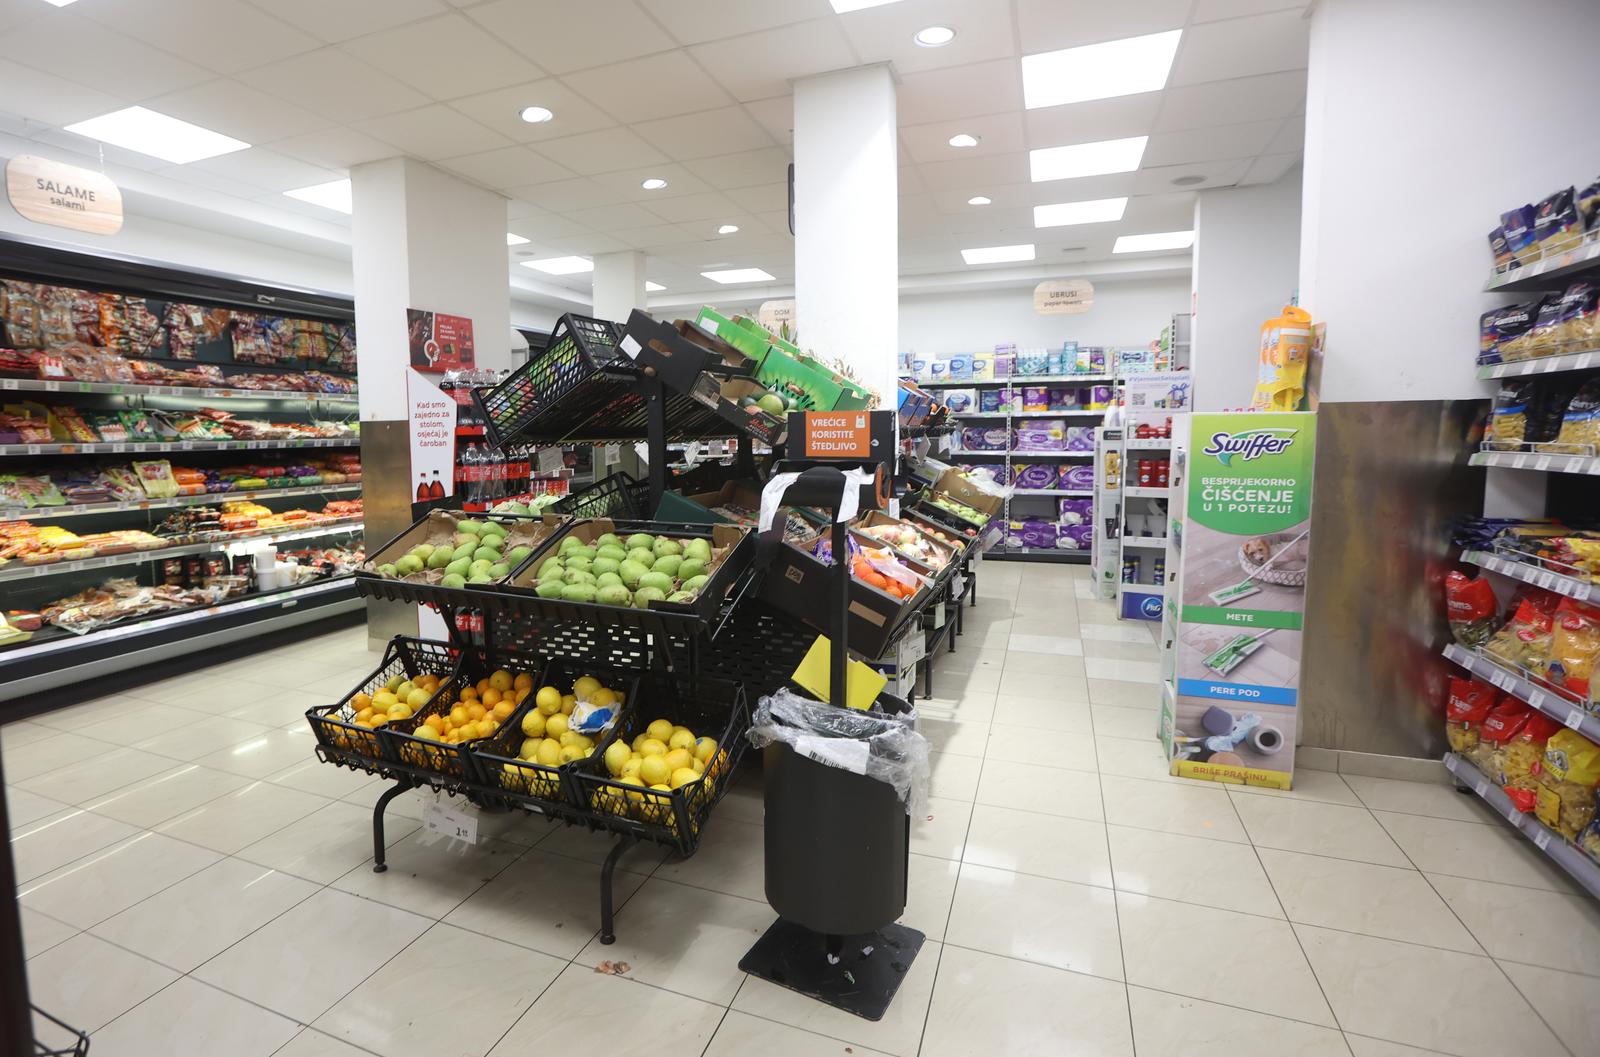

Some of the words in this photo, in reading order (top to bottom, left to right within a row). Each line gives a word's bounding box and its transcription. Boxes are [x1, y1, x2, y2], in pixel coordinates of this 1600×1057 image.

[37, 179, 96, 202] SALAME
[50, 197, 86, 211] salami
[416, 401, 430, 410] Kad
[431, 401, 446, 409] smo
[414, 411, 440, 419] zajedno
[811, 418, 847, 428] VREĆICE
[811, 430, 854, 440] KORISTITE
[811, 441, 857, 452] ŠTEDLJIVO
[1203, 432, 1292, 460] Swiffer
[1201, 477, 1297, 487] BESPRIJEKORNO
[1202, 486, 1294, 503] ČIŠĆENJE
[1203, 503, 1212, 512] U
[1218, 503, 1223, 512] 1
[1228, 504, 1292, 514] POTEZU!
[1226, 613, 1254, 622] METE
[1210, 686, 1236, 696] PERE
[1238, 687, 1261, 697] POD
[1193, 766, 1220, 776] BRIŠE
[1224, 769, 1267, 781] PRAŠINU
